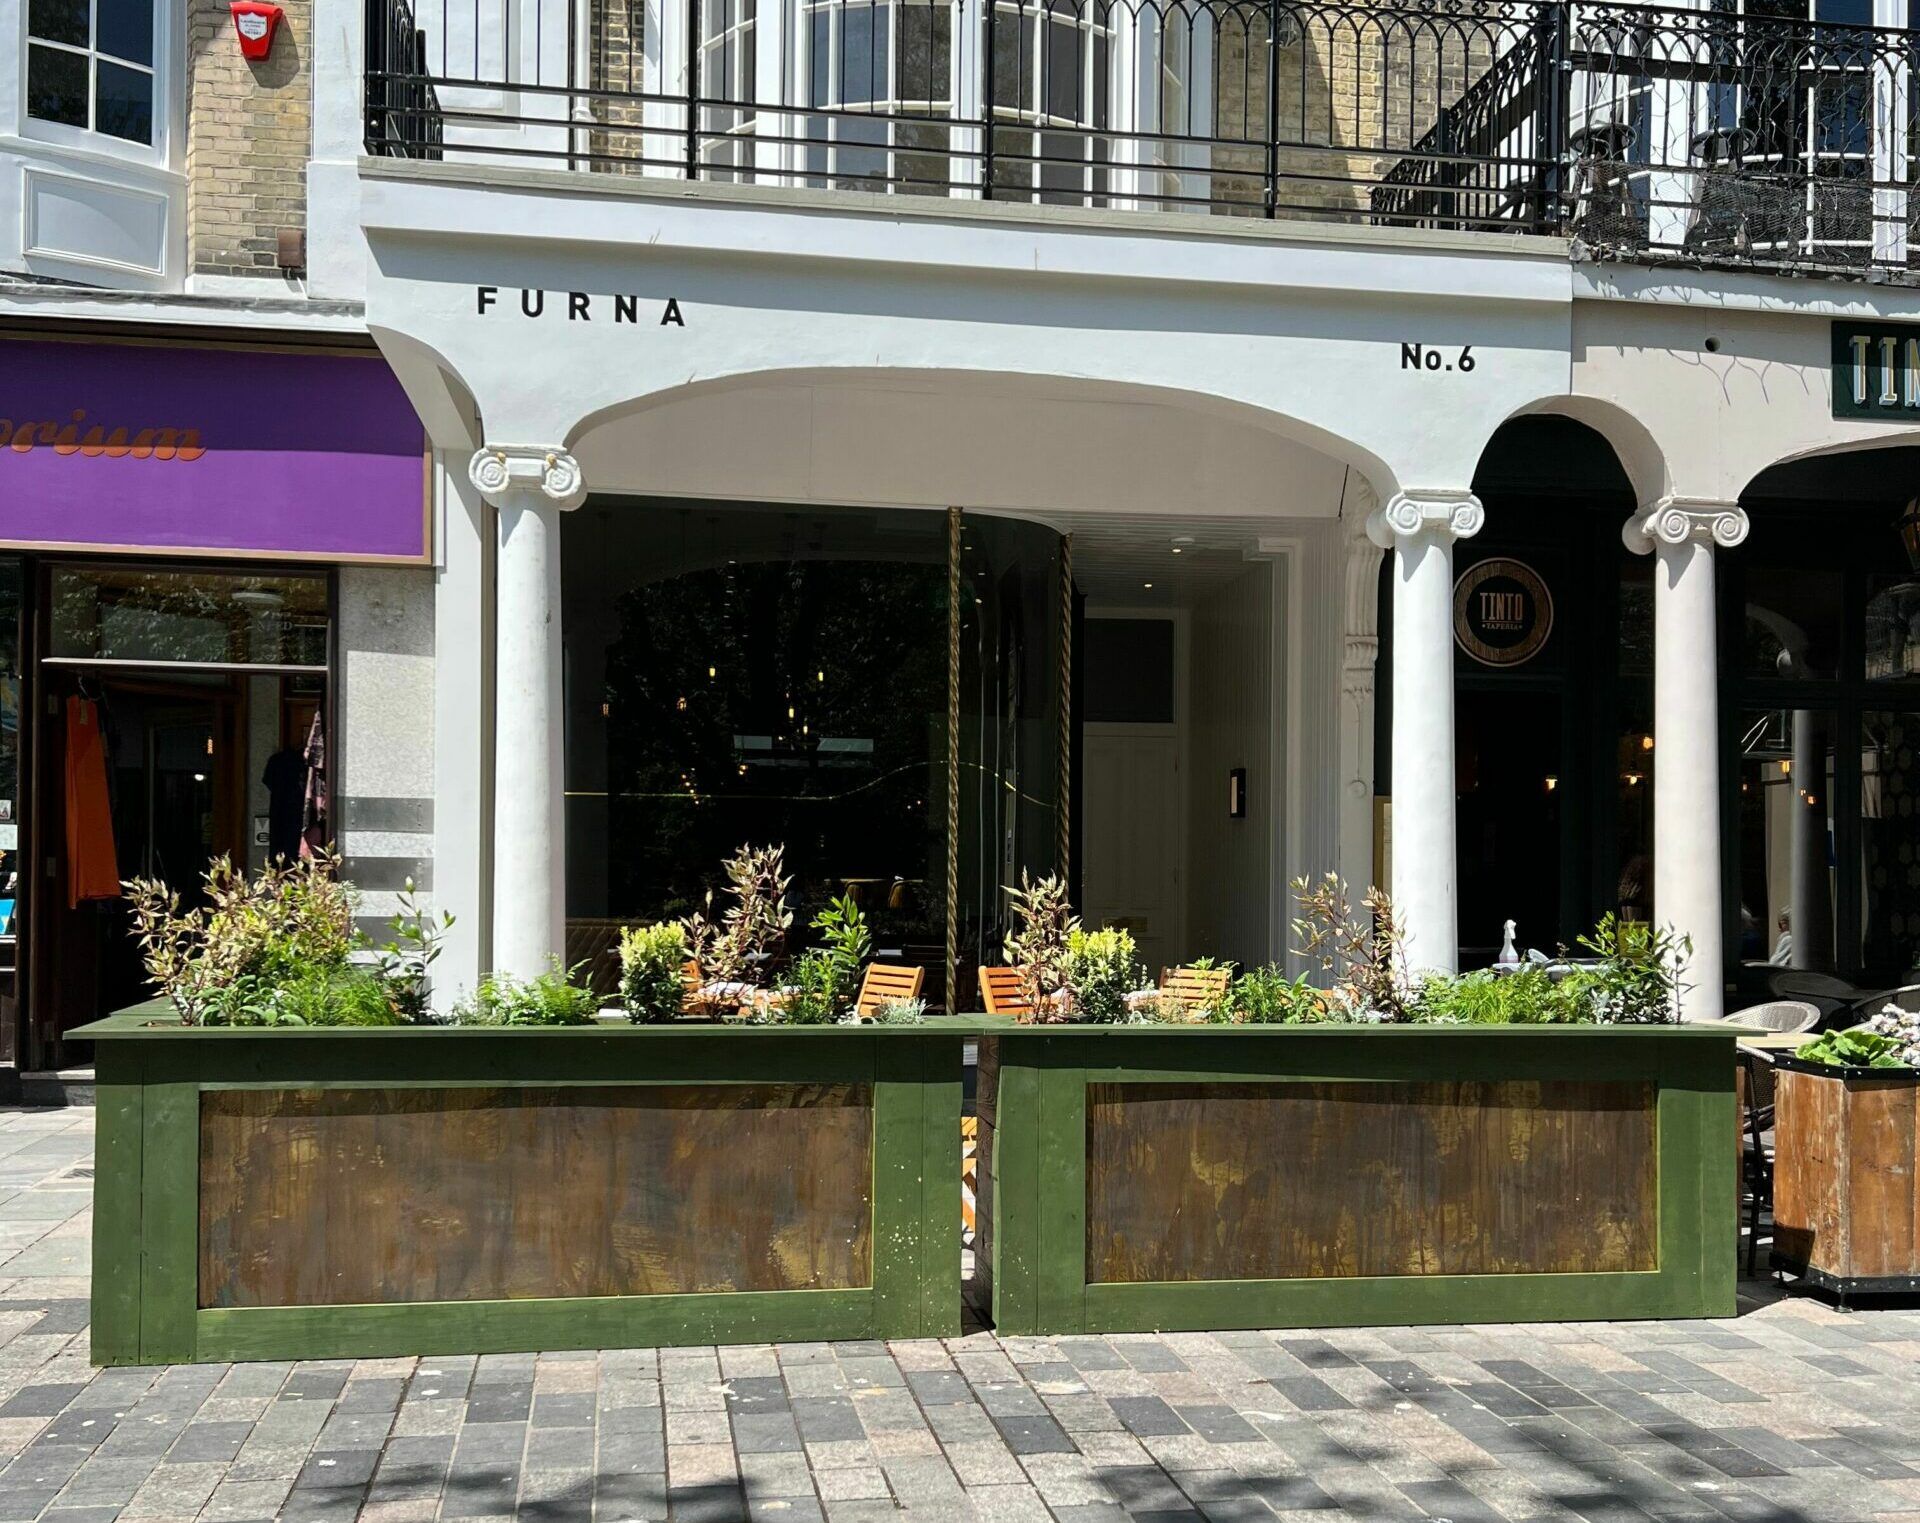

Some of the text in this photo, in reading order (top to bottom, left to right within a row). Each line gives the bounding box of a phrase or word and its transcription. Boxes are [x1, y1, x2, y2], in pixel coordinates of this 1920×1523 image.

[477, 286, 685, 327] FURNA
[1401, 342, 1476, 372] No.6
[1479, 592, 1523, 621] TINTO
